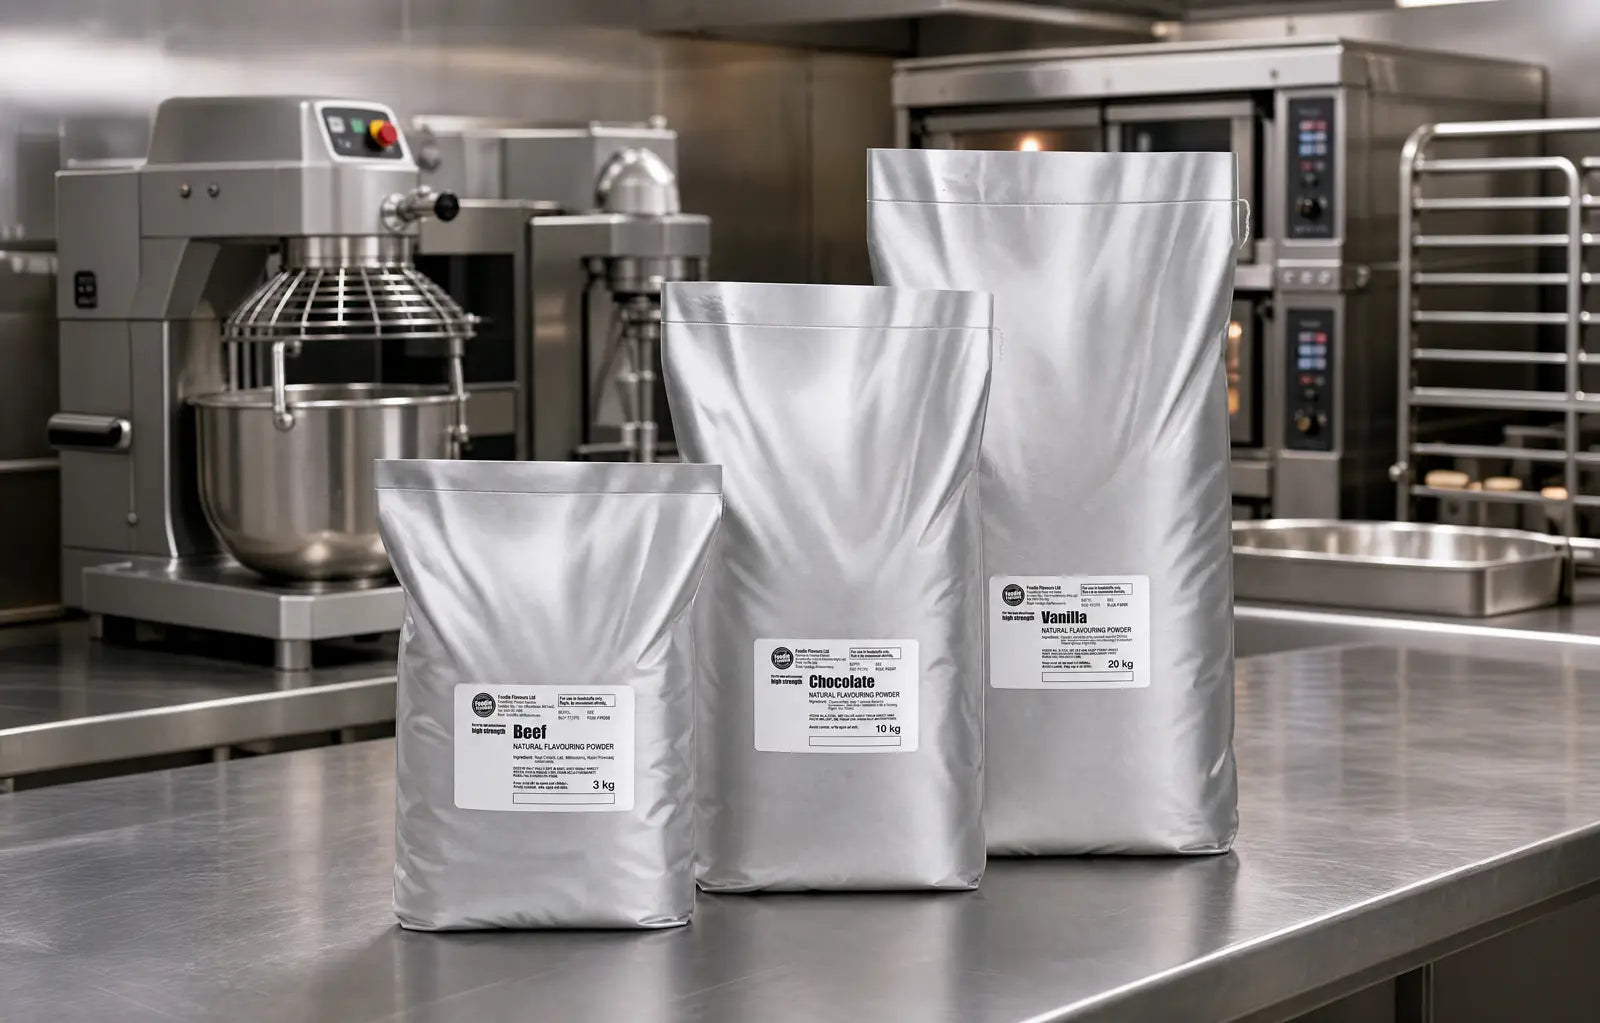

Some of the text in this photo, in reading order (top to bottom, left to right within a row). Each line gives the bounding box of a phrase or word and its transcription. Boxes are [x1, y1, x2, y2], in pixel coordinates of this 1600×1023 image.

[1041, 611, 1087, 624] Vanilla
[1122, 660, 1133, 669] kg
[809, 675, 875, 688] Chocolate
[514, 724, 547, 739] Beef
[890, 724, 900, 734] kg
[593, 780, 615, 791] 3 kg
